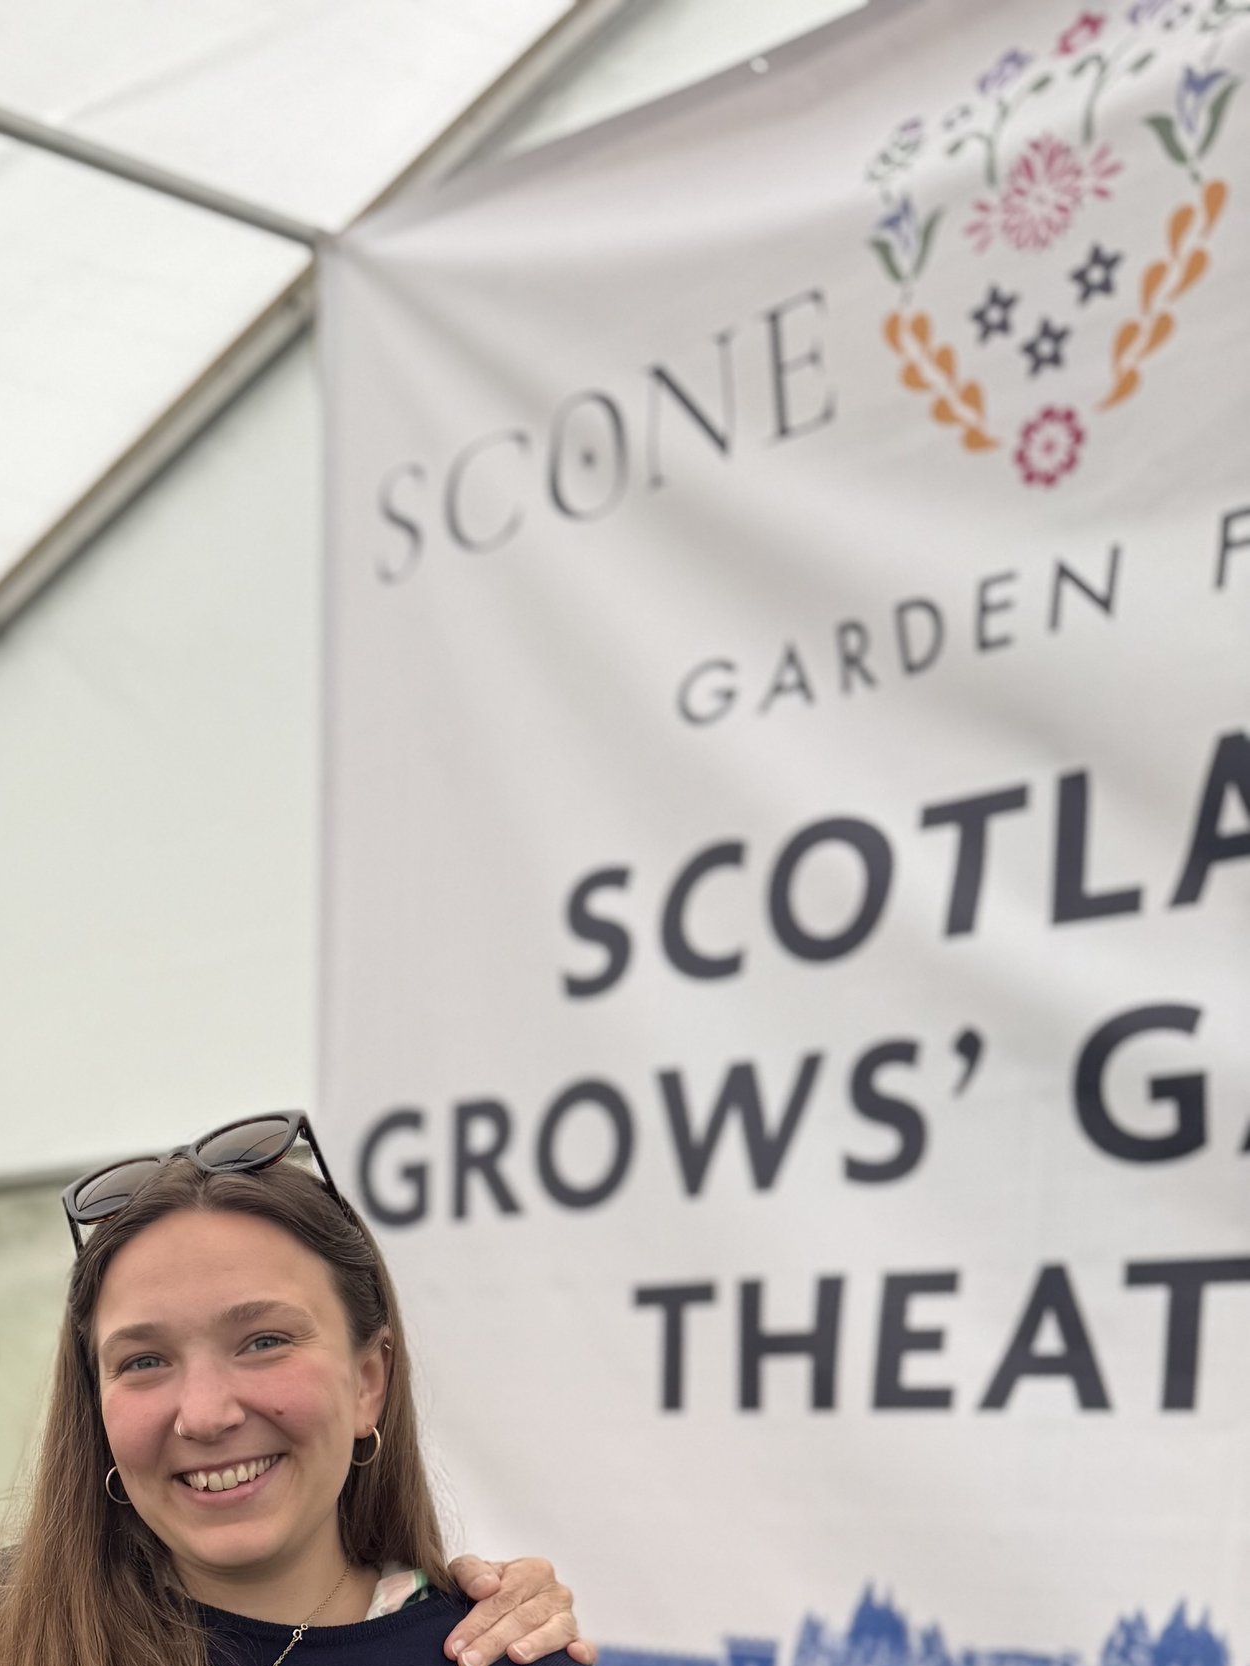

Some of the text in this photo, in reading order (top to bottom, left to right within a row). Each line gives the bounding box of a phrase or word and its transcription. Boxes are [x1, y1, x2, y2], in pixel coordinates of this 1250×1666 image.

[374, 287, 838, 586] SCONE
[674, 542, 1124, 729] GARDEN
[562, 729, 1250, 1001] SCOTLA
[356, 1001, 1250, 1231] GROWS’ G
[631, 1253, 1250, 1414] THEAT
